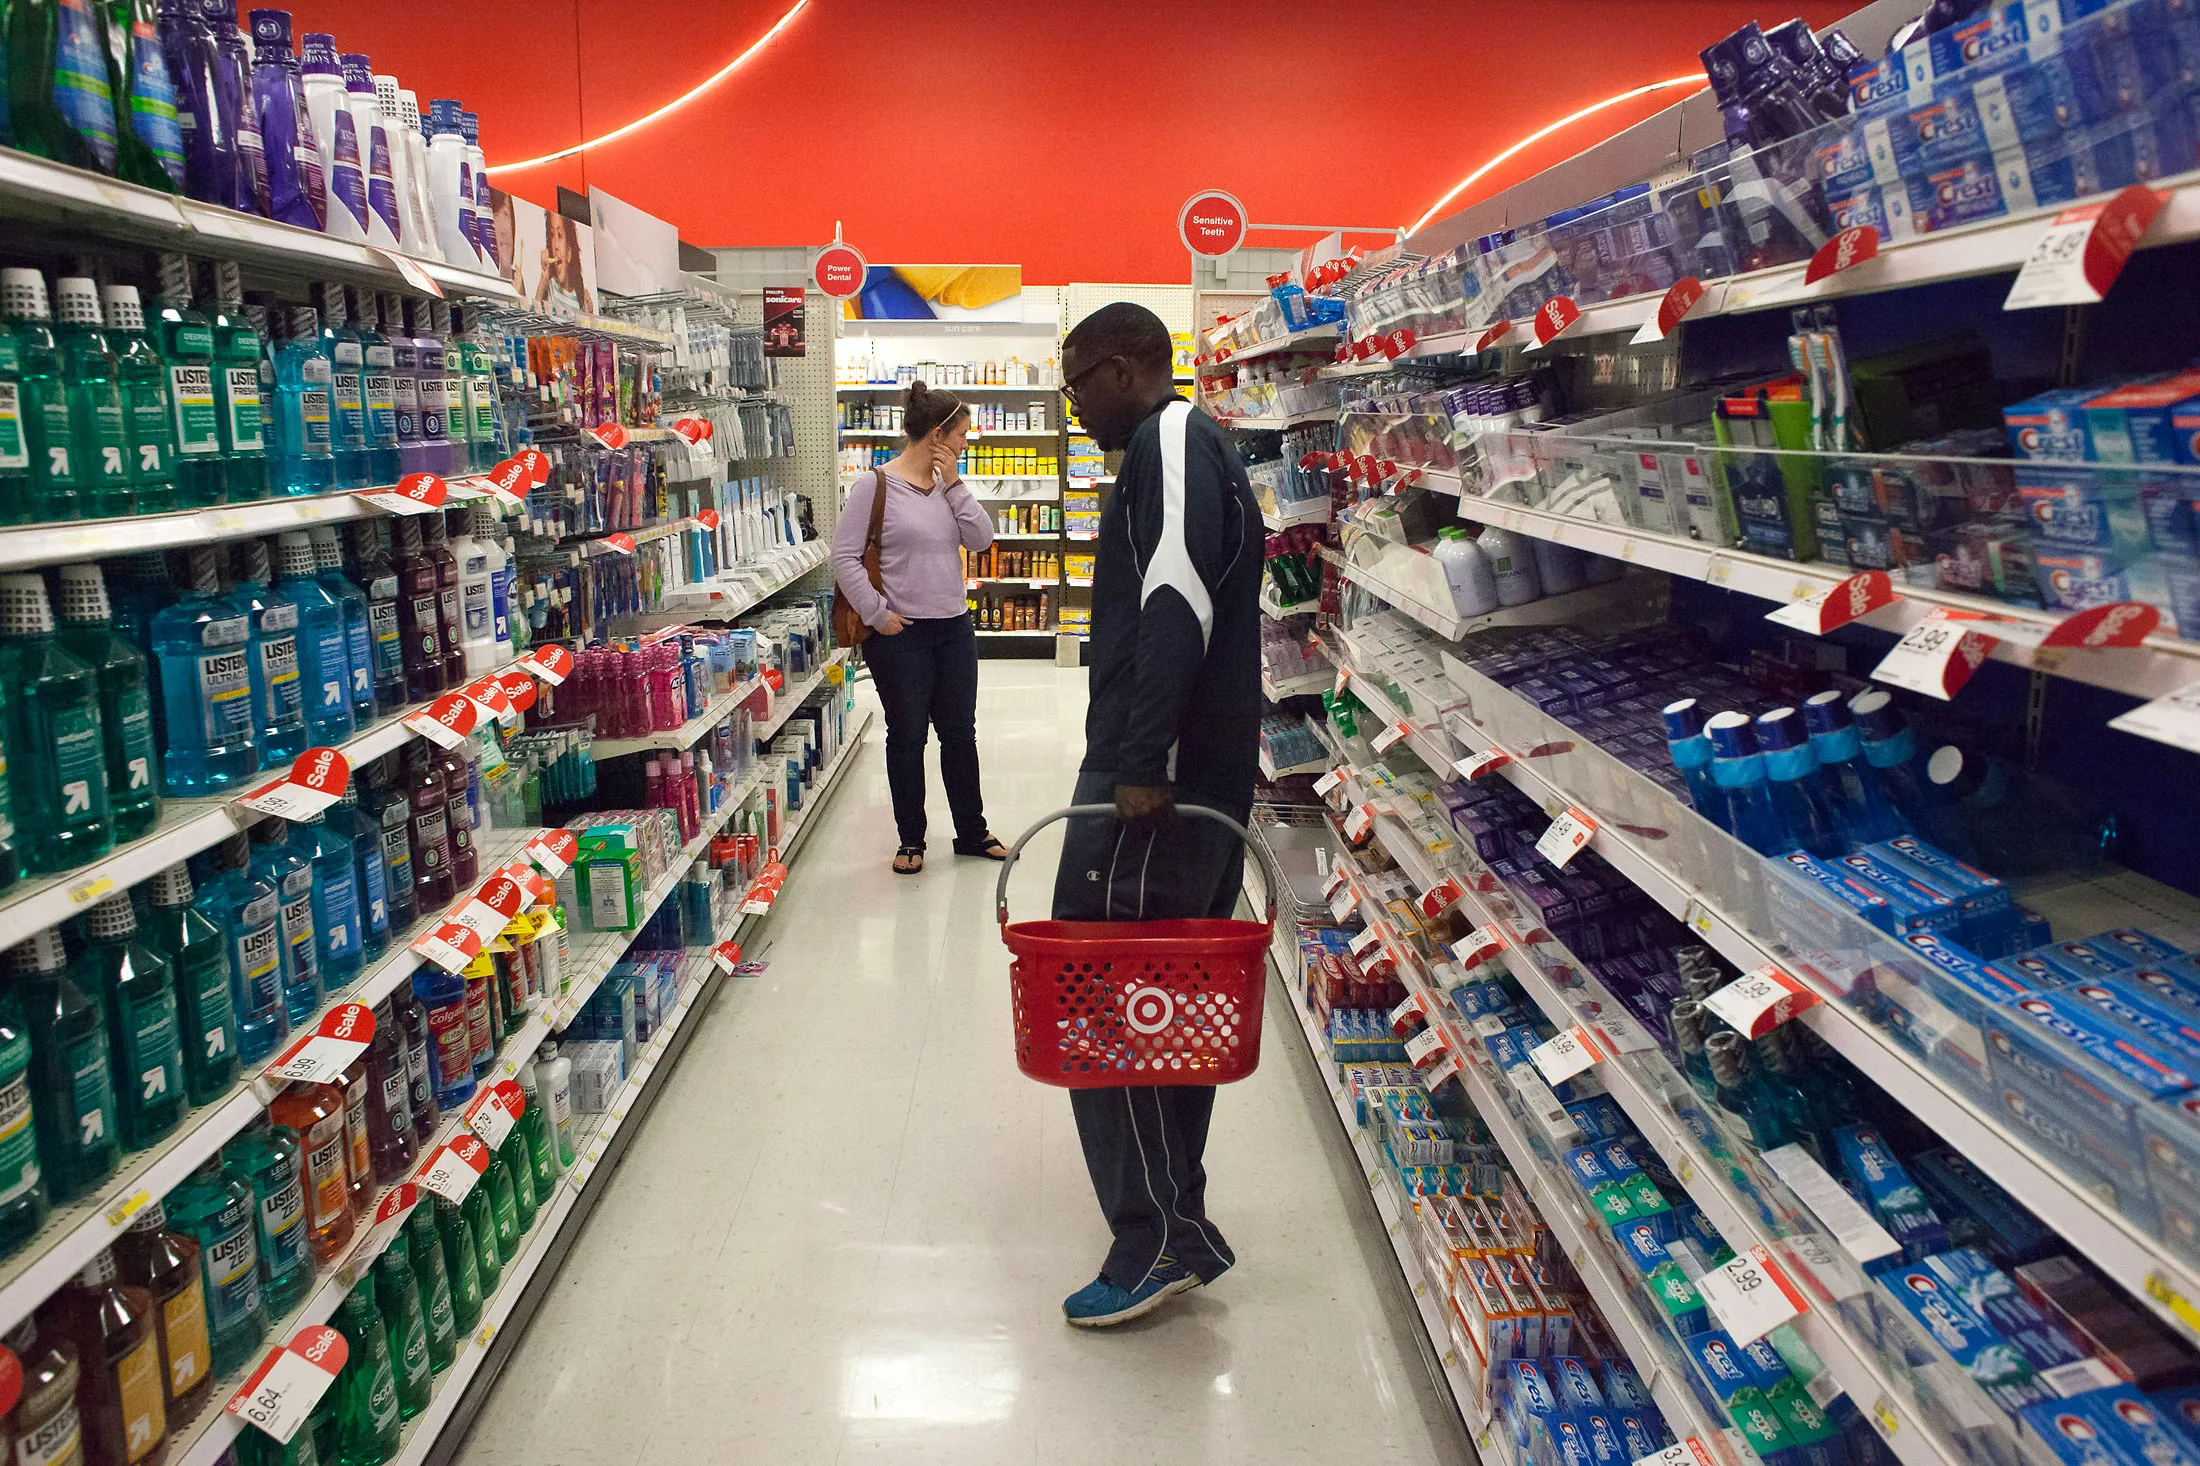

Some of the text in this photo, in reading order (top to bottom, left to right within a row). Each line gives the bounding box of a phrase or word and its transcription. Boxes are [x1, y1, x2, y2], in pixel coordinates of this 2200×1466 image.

[1963, 22, 2022, 61] Crest
[1857, 76, 1902, 103] Crest
[1938, 178, 1994, 206] Crest
[1193, 215, 1233, 226] Sensitive
[1200, 226, 1225, 237] Teeth
[1835, 230, 1863, 271] Sale
[828, 264, 852, 272] Power
[766, 295, 802, 304] sonicare
[1546, 300, 1565, 331] Sale
[1366, 336, 1376, 354] Sale
[1393, 331, 1406, 352] Sale
[525, 452, 537, 470] ale
[1336, 451, 1345, 466] Sale
[1358, 457, 1368, 474] Sale
[1376, 462, 1388, 478] Sale
[409, 475, 435, 500] Sale
[500, 464, 524, 490] Sale
[1850, 574, 1872, 616] Sale
[1902, 626, 1949, 651] 2.99
[543, 647, 564, 669] Sale
[477, 686, 498, 704] Sale
[506, 680, 533, 699] Sale
[441, 699, 467, 726] Sale
[306, 750, 334, 788] Sale
[551, 833, 572, 854] Sale
[1891, 838, 1946, 866] Crest
[517, 868, 535, 886] Sale
[1786, 854, 1838, 883] Crest
[1844, 856, 1896, 884] Crest
[489, 880, 513, 908] Sale
[1431, 888, 1448, 908] Sale
[448, 927, 470, 948] Sale
[1906, 934, 1978, 972] Crest
[1735, 976, 1772, 999] 2.99
[335, 1004, 361, 1038] Sale
[2018, 1000, 2106, 1047] Crest
[1552, 1034, 1576, 1056] 3.99
[284, 1057, 317, 1078] 6.99
[474, 1112, 492, 1135] 5.79
[460, 1140, 482, 1160] Sale
[1608, 1143, 1636, 1170] Crest
[1580, 1152, 1606, 1176] Crest
[427, 1169, 450, 1190] 5.99
[387, 1188, 402, 1216] Sale
[1607, 1194, 1628, 1216] scope
[1634, 1226, 1666, 1255] Crest
[1728, 1258, 1762, 1292] 2.99
[1668, 1278, 1692, 1304] scope
[1904, 1274, 1976, 1329] Crest
[306, 1328, 338, 1362] Sale
[1752, 1340, 1785, 1371] rest
[1708, 1340, 1745, 1380] Crest
[1518, 1361, 1552, 1415] Crest
[248, 1386, 282, 1424] 6.64
[1792, 1399, 1822, 1429] scope
[1590, 1416, 1616, 1453] Crest
[1622, 1418, 1650, 1455] Crest
[1748, 1408, 1777, 1442] scope
[1560, 1422, 1588, 1463] Crest
